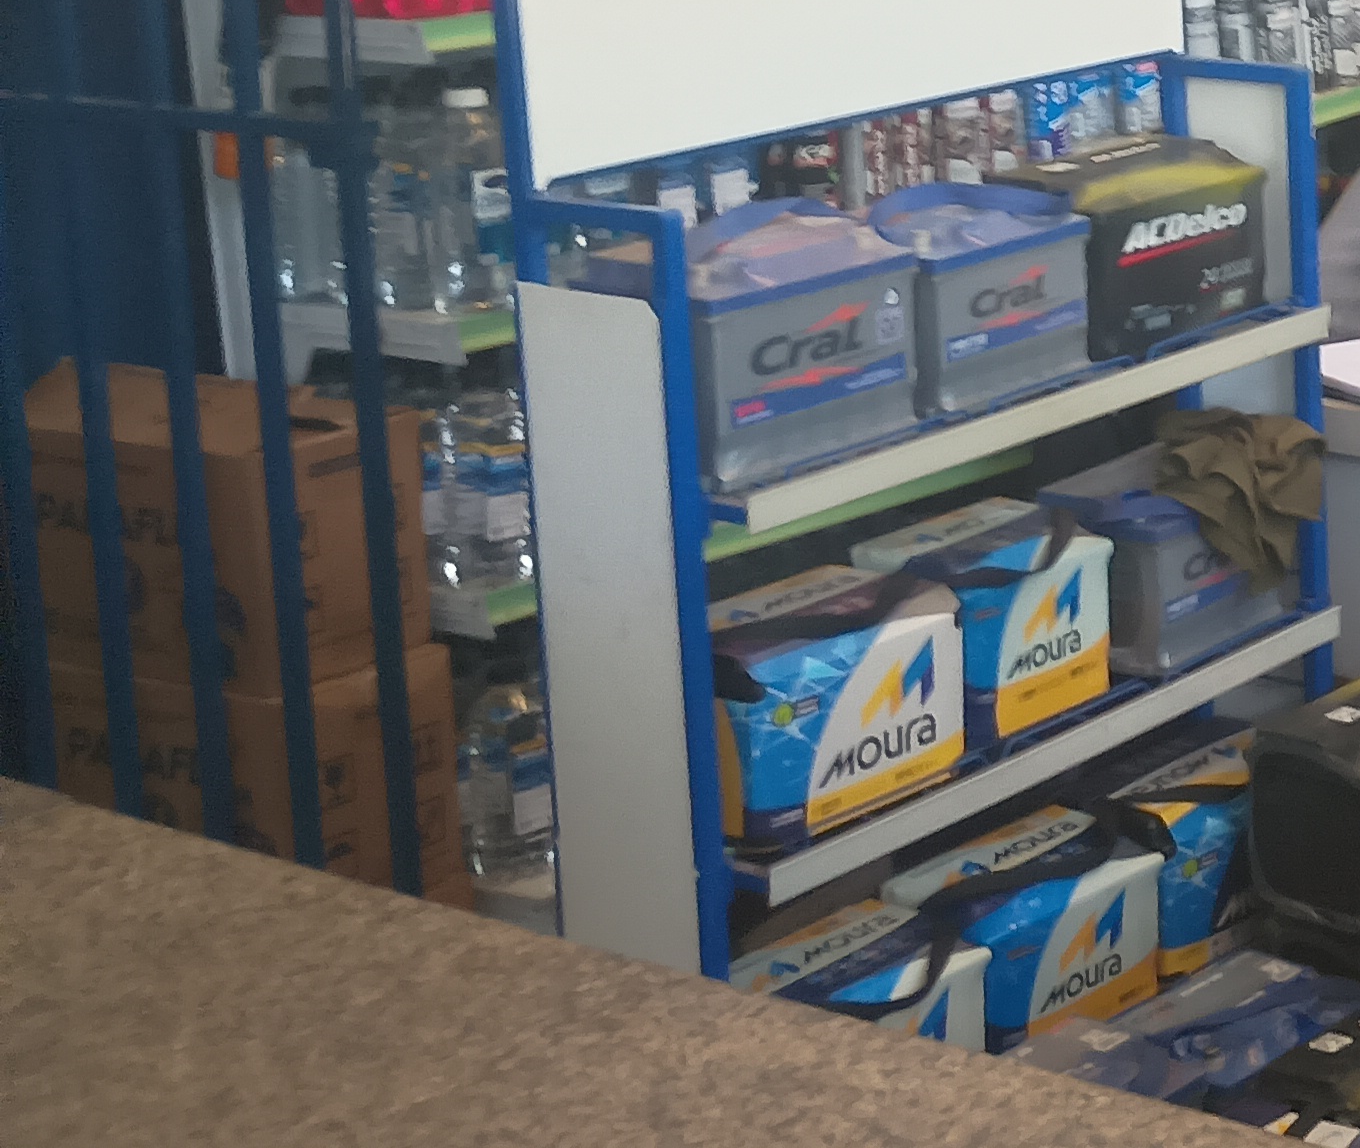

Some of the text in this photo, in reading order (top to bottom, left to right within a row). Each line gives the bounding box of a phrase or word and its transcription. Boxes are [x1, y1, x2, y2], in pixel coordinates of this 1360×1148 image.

[1120, 203, 1248, 254] ACDelco
[970, 274, 1047, 318] Cral
[750, 316, 864, 376] Cral
[1007, 628, 1082, 680] Moura
[819, 712, 937, 789] Moura
[993, 821, 1079, 863] Moura
[1040, 953, 1123, 1014] Moura
